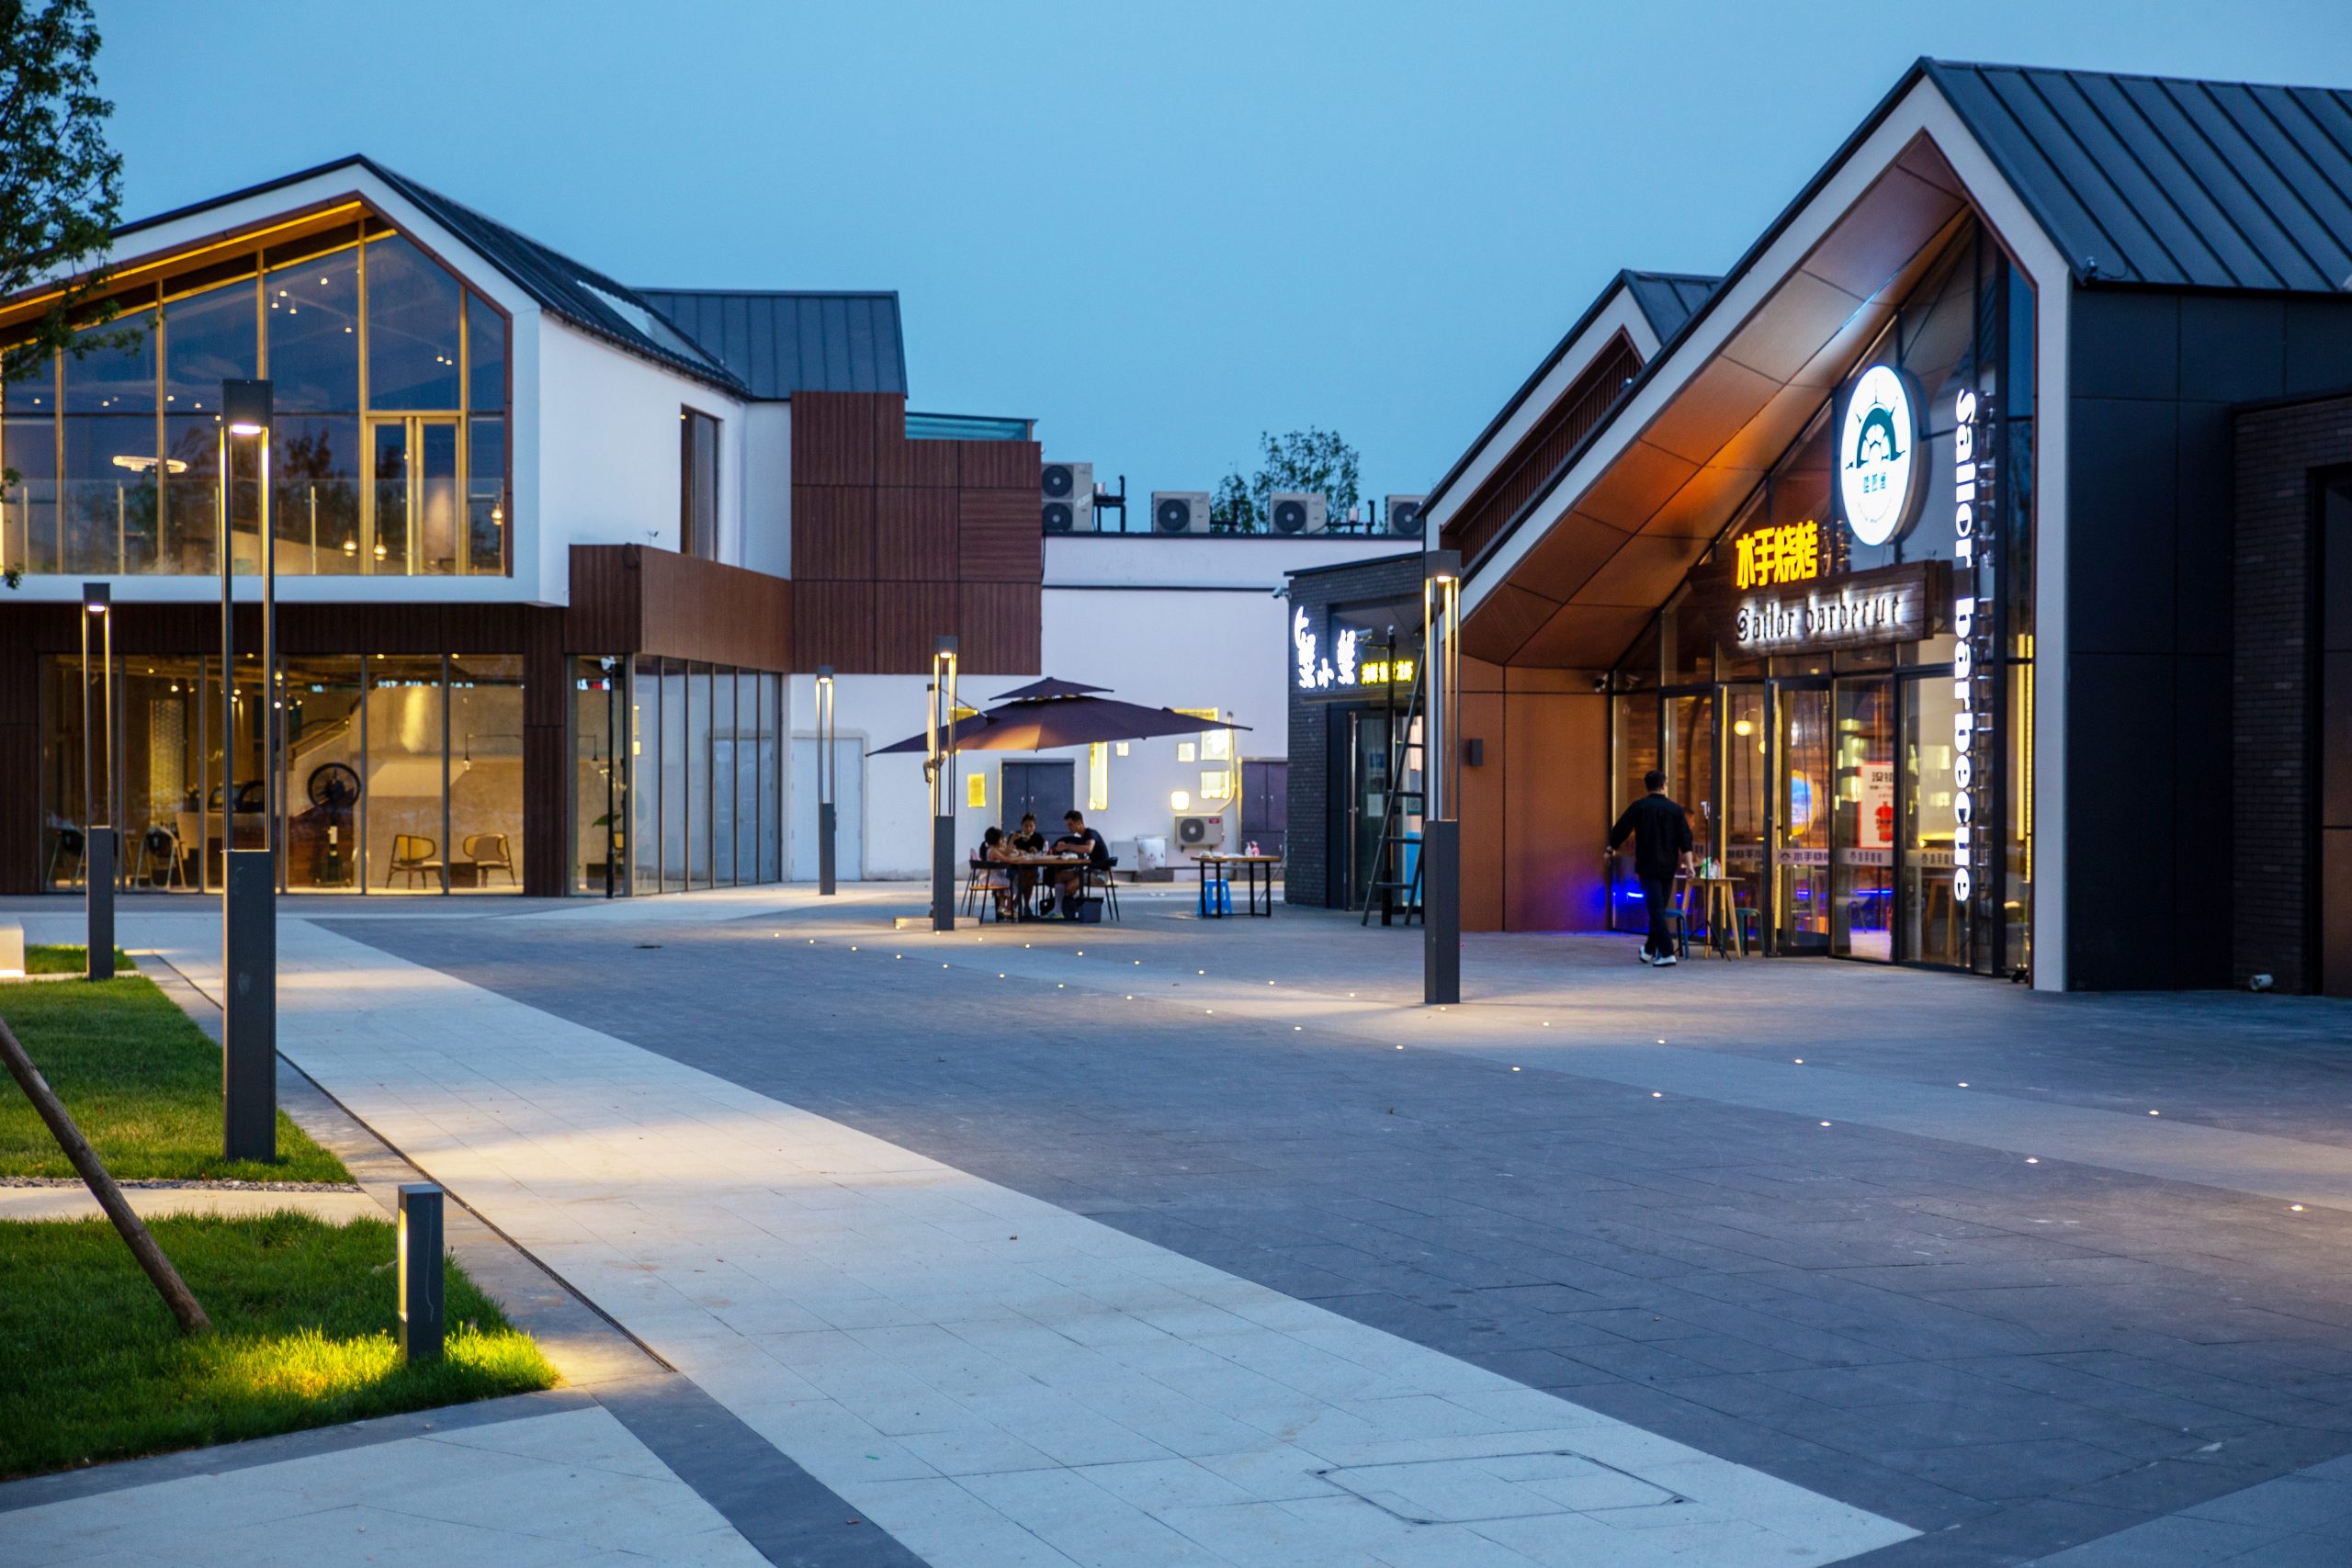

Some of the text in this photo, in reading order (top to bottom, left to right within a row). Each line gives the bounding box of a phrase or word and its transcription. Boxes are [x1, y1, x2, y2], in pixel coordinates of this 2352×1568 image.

[1736, 520, 1818, 590] 水手烧烤
[1736, 592, 1900, 641] Sailor barbecue
[1954, 389, 1976, 902] Sailor barbecue
